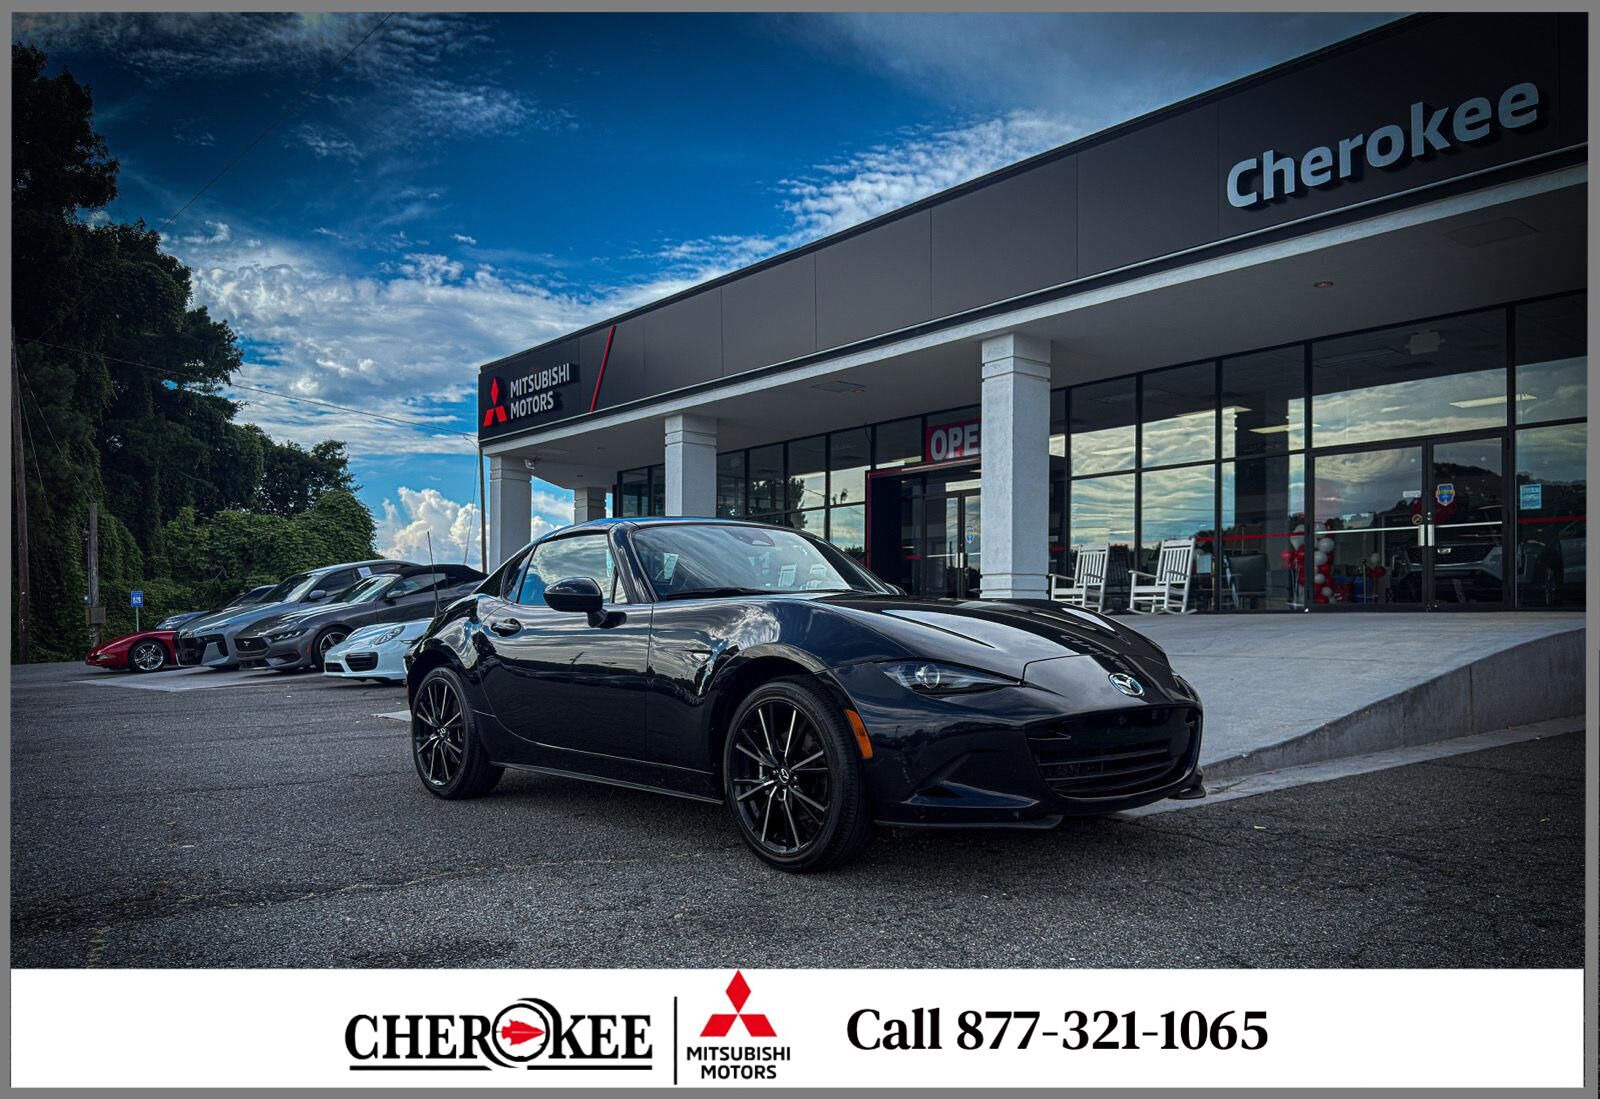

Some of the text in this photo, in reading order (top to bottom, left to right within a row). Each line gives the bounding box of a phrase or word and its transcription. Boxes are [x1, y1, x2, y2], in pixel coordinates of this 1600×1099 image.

[1226, 82, 1540, 208] Cherokee
[509, 362, 570, 398] MITSUBISHI
[509, 390, 554, 420] MOTORS
[930, 423, 982, 461] OPE
